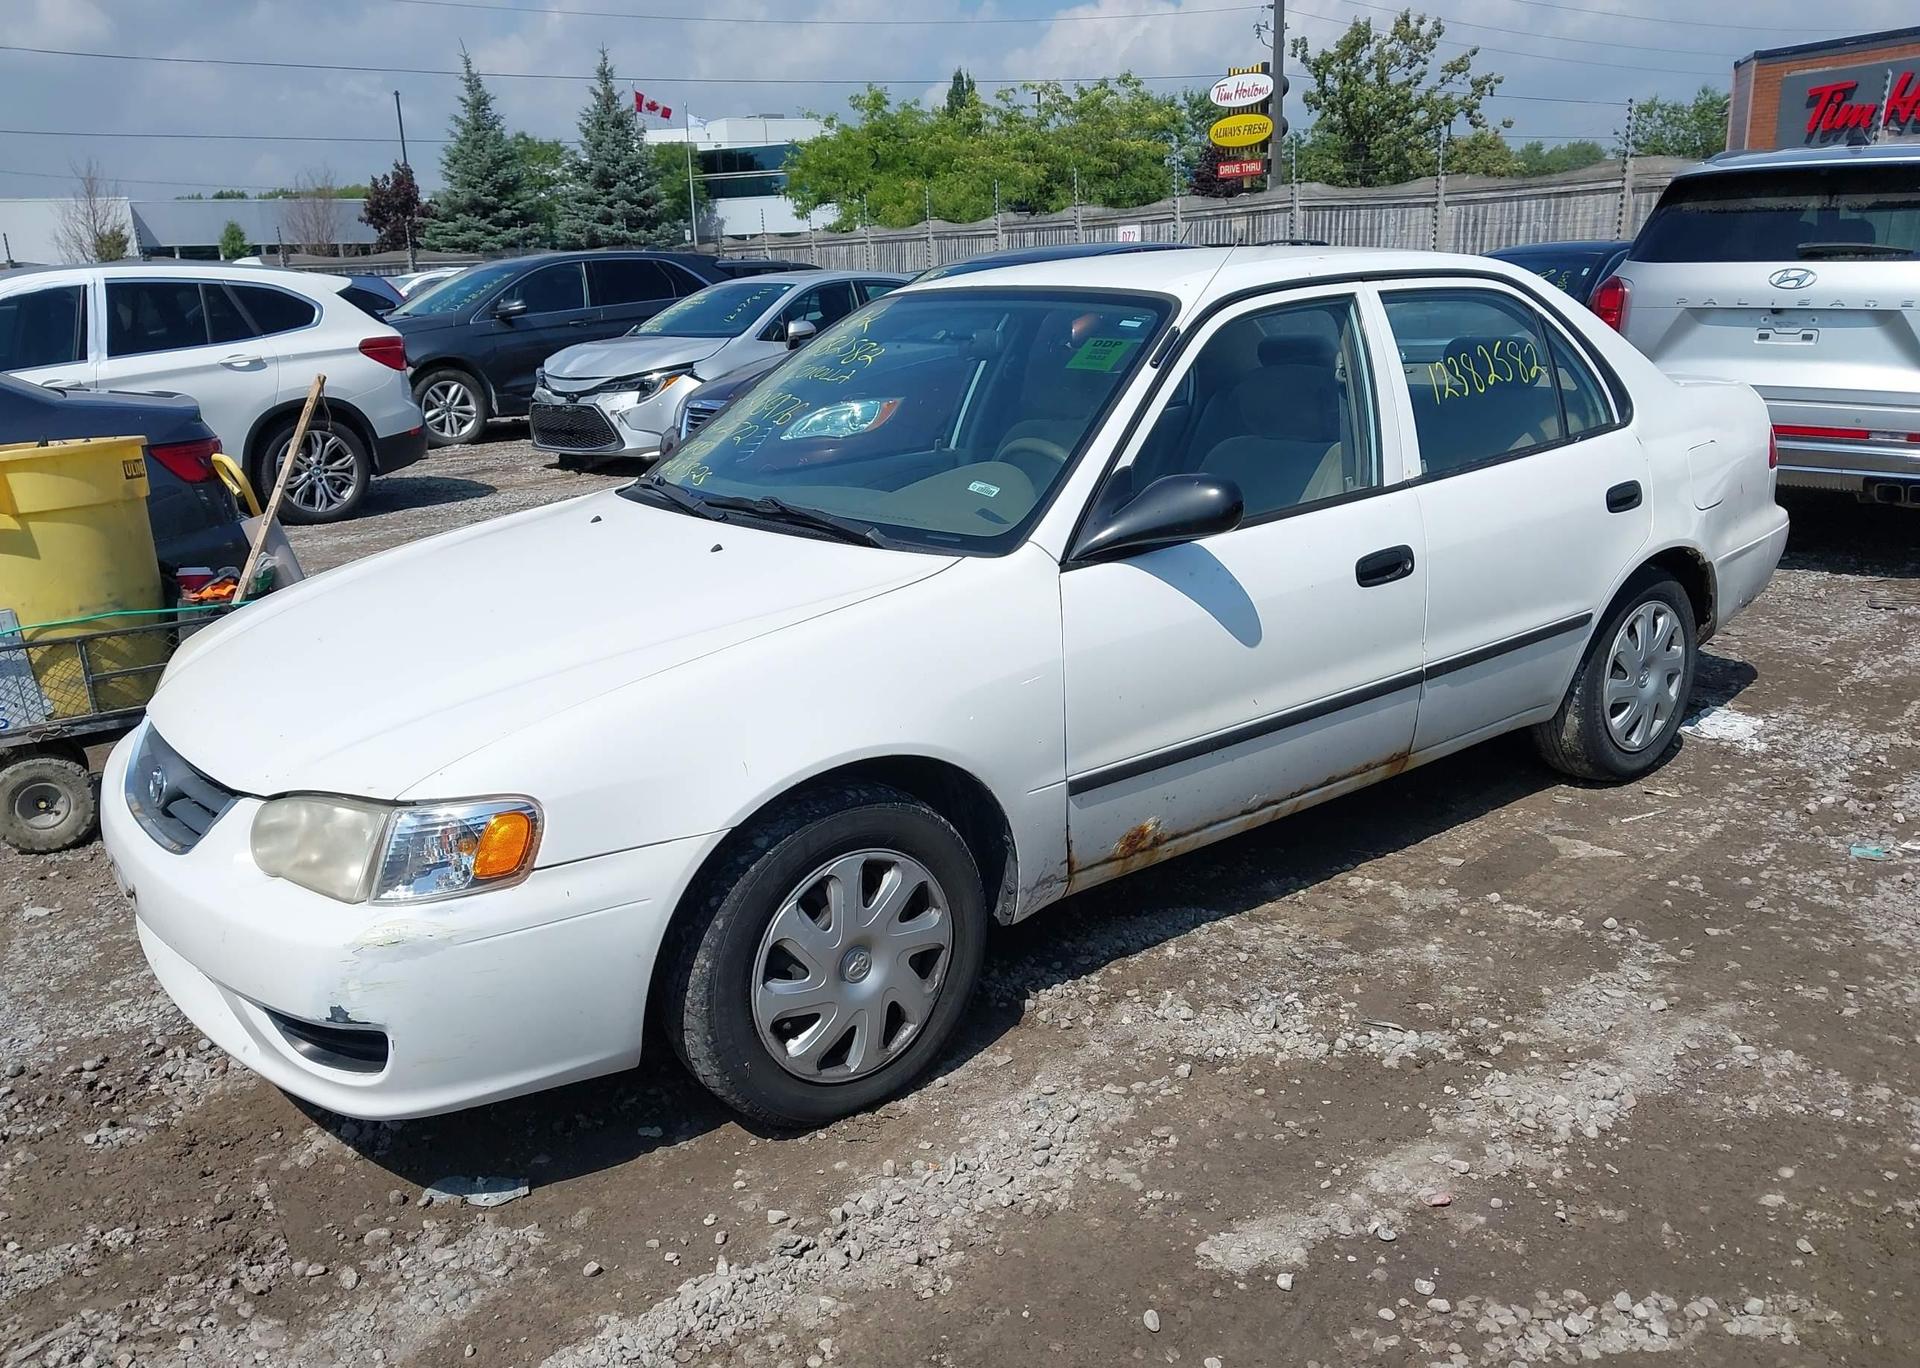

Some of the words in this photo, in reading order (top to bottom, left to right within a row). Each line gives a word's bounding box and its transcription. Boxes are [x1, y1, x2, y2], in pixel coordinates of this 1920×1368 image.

[1215, 83, 1233, 103] Tim
[1234, 81, 1269, 100] Hortons
[1807, 80, 1877, 134] Tim
[1882, 71, 1920, 125] H
[1213, 125, 1242, 139] ALWAYS
[1242, 122, 1269, 135] FRESH
[1219, 164, 1241, 175] DRIVE
[1241, 161, 1261, 173] THRU
[1428, 340, 1547, 405] 12382582
